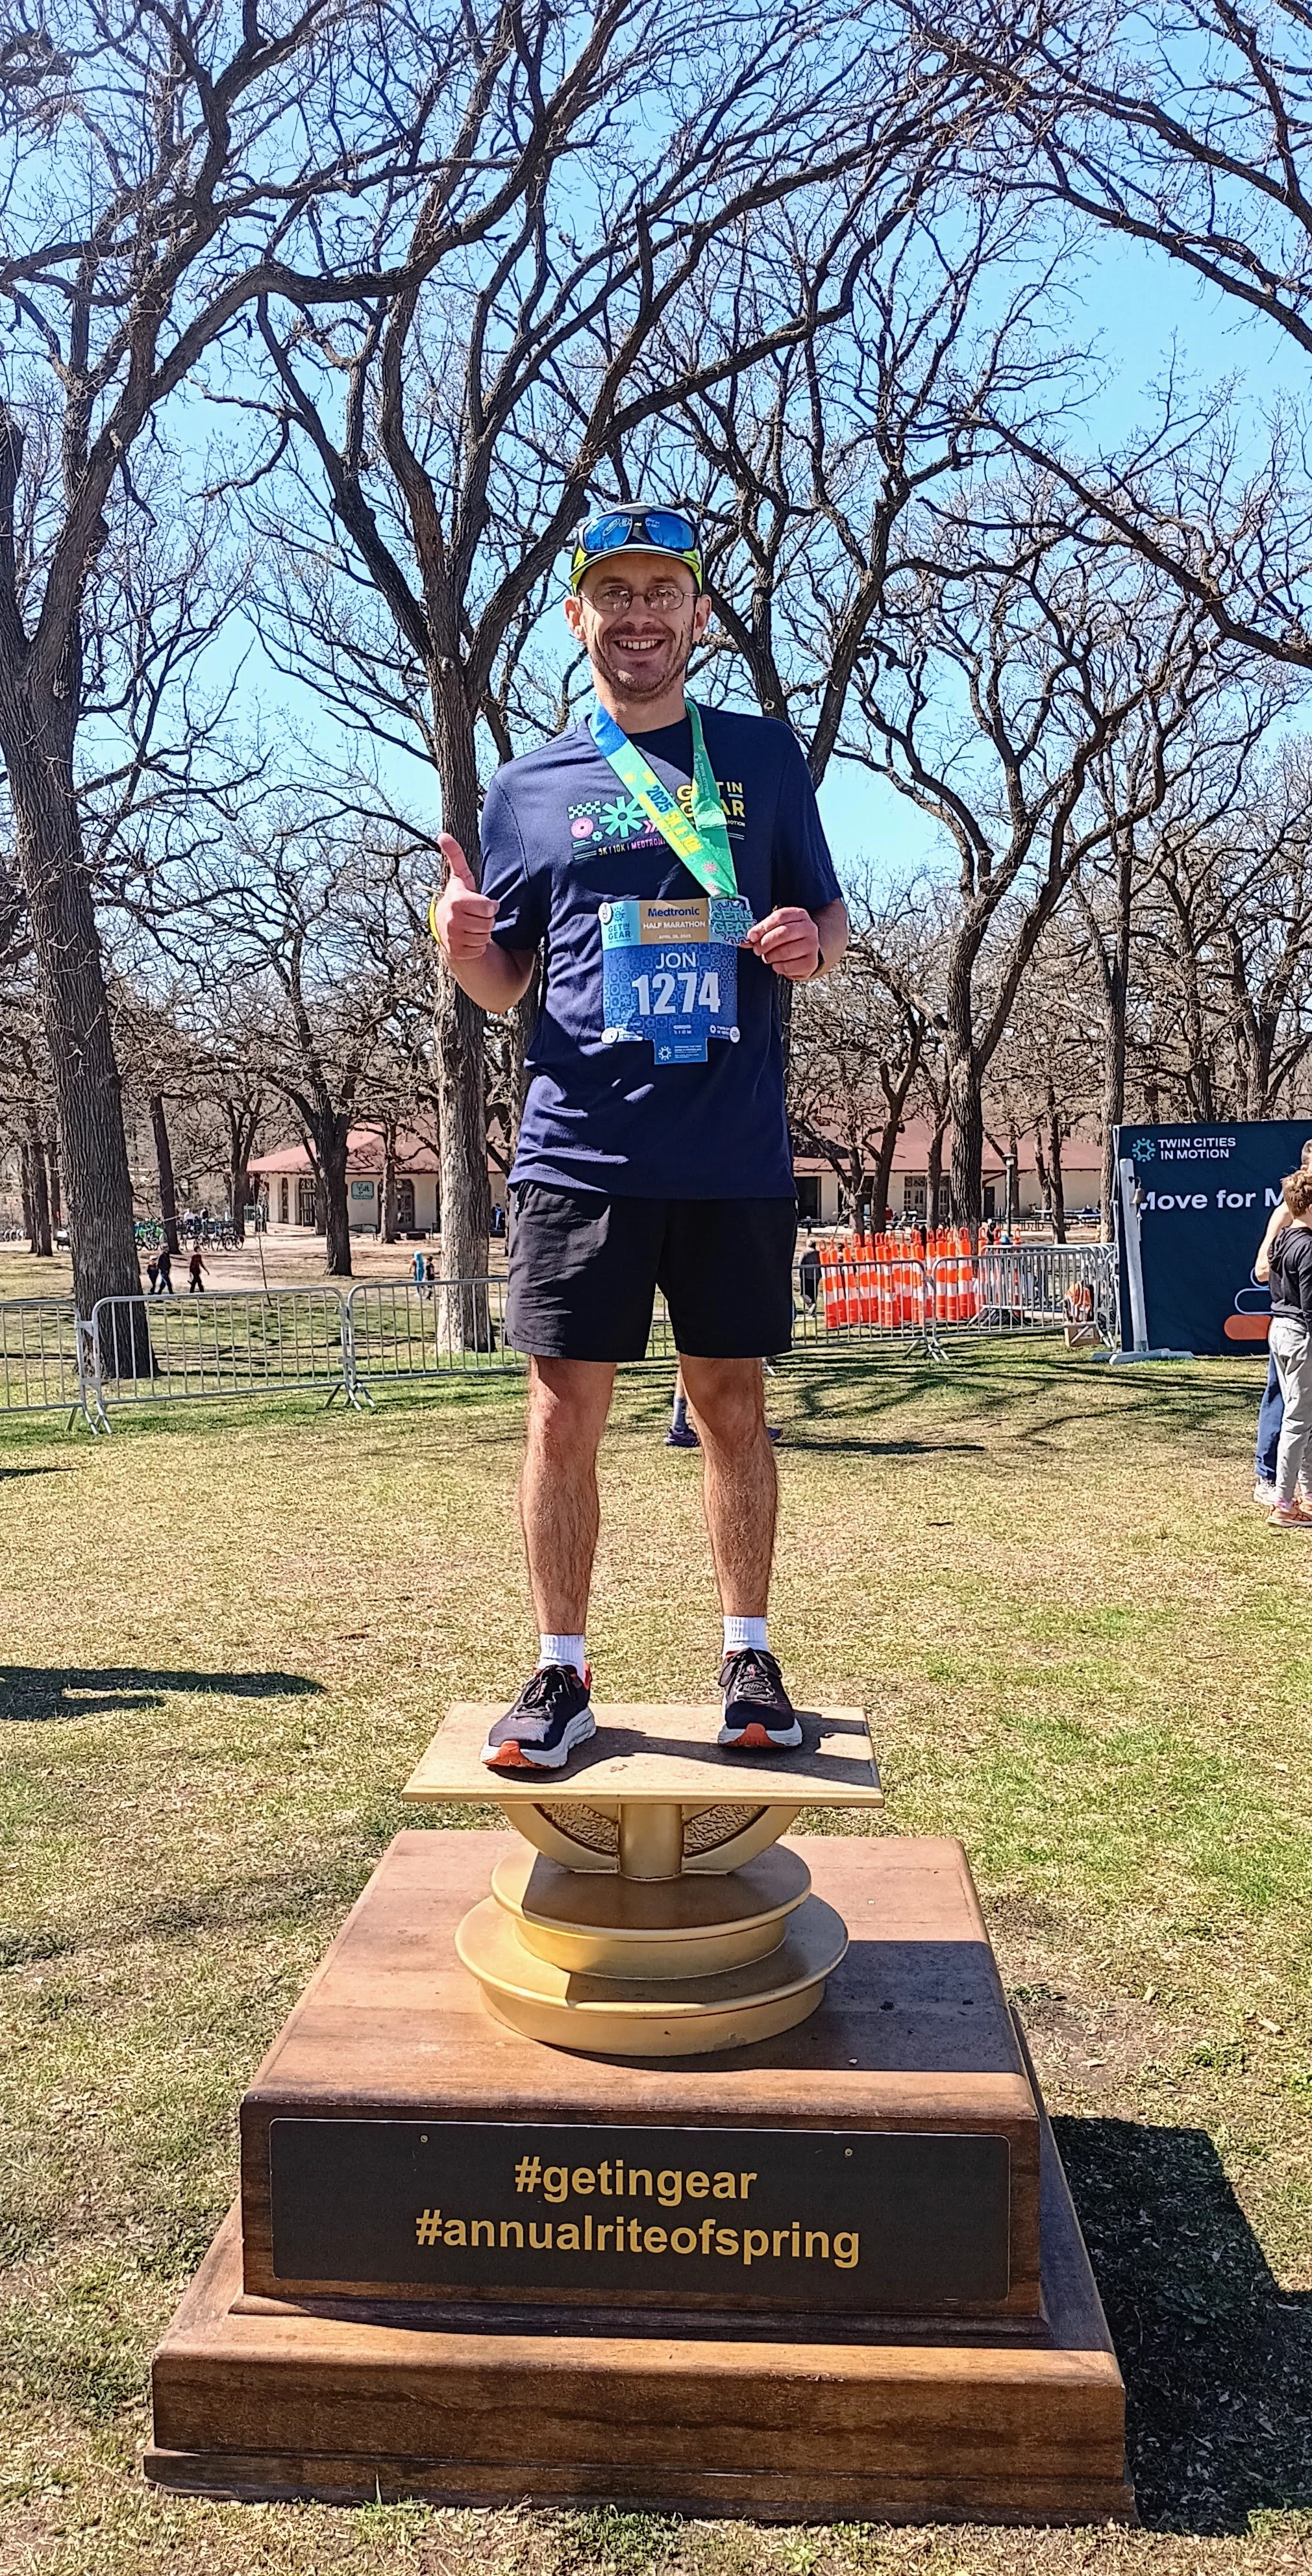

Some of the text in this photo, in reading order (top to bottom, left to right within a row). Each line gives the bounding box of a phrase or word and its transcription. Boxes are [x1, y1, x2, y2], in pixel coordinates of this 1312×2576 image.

[646, 785, 673, 812] 2025
[676, 782, 743, 801] GT IN
[680, 799, 745, 818] GAR
[648, 907, 699, 917] Medtronic
[712, 910, 739, 921] GET
[608, 923, 623, 932] GET
[609, 931, 630, 940] GEAR
[655, 952, 696, 969] JON
[631, 972, 721, 1016] 1274
[1157, 1138, 1236, 1148] TWIN CITIES
[1161, 1149, 1230, 1160] IN MOTION
[1216, 1190, 1256, 1208] for
[515, 2156, 758, 2207] #getingear
[415, 2209, 860, 2269] #annualriteofspring
